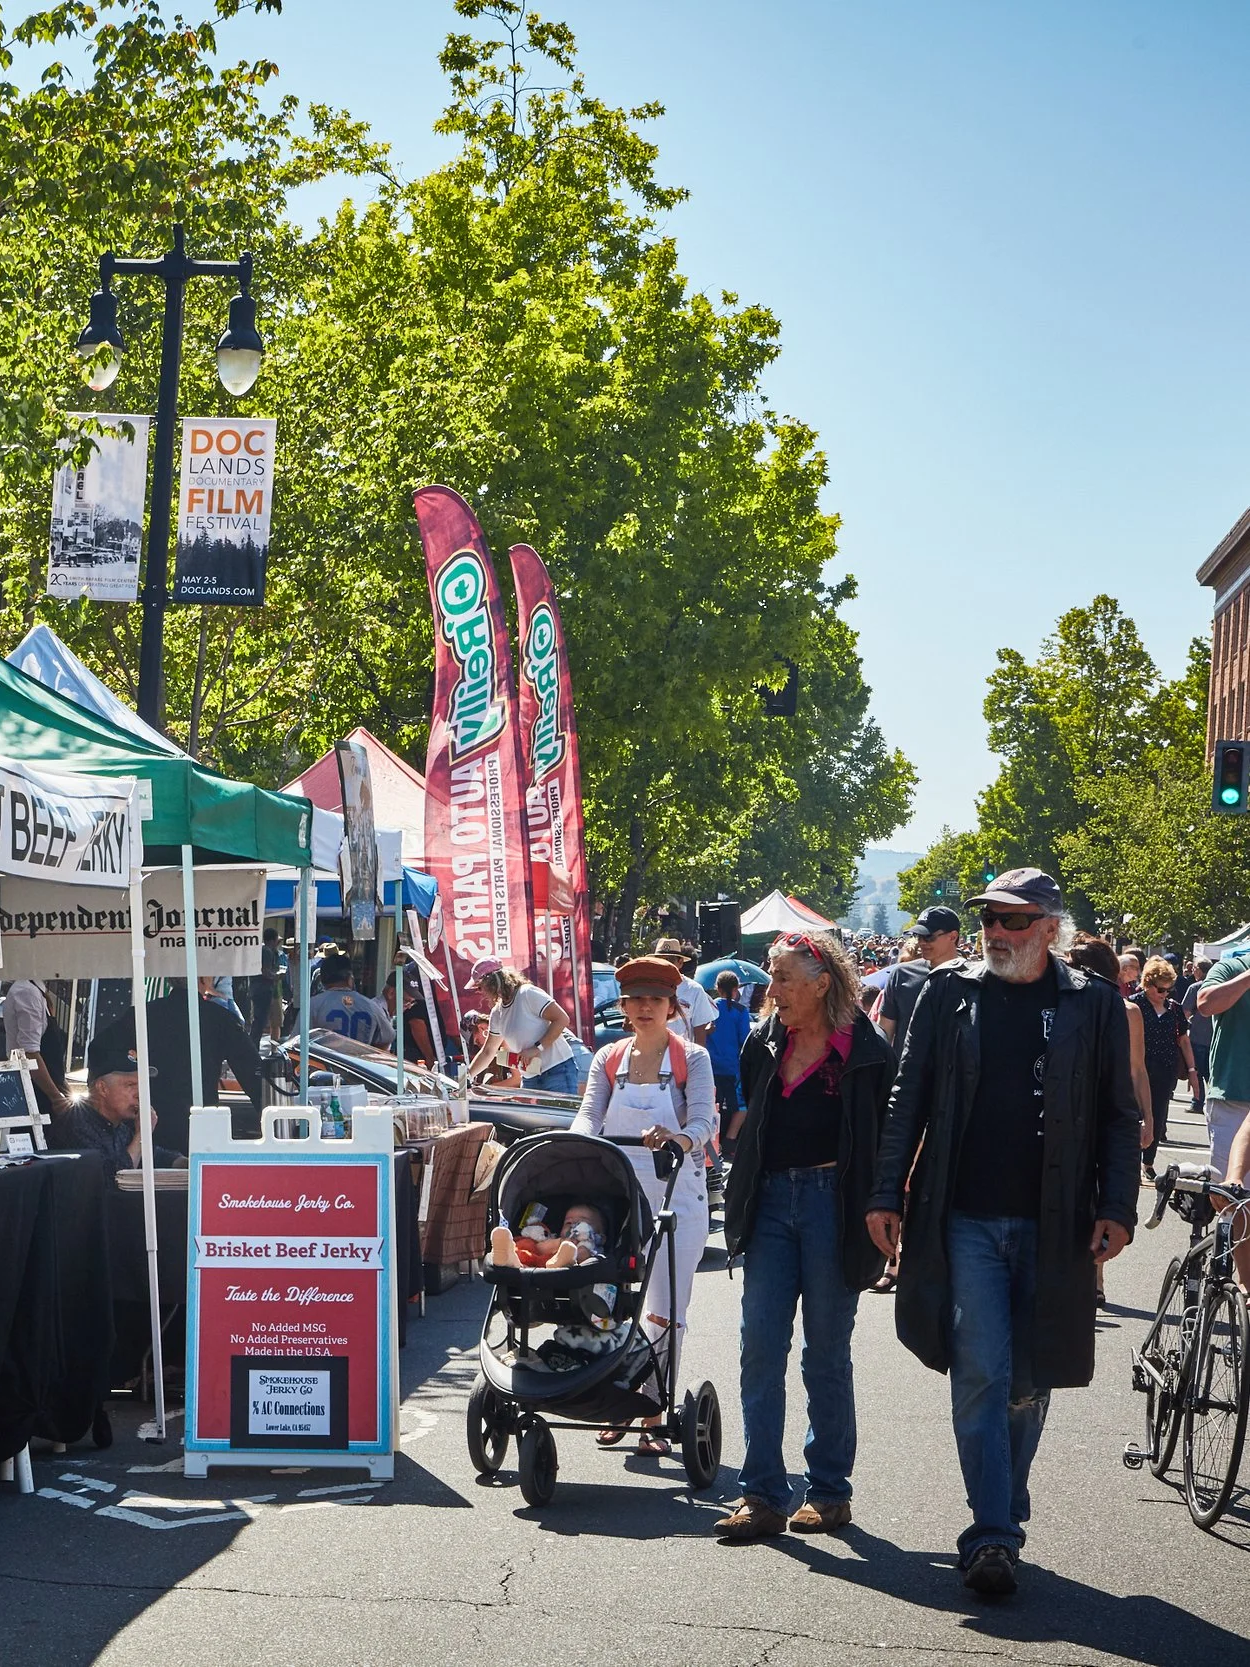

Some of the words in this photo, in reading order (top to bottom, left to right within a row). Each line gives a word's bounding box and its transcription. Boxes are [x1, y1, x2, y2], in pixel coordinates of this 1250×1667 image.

[190, 429, 265, 456] DOC
[189, 457, 265, 476] LANDS
[188, 477, 264, 487] DOCUMENTARY
[187, 489, 264, 515] FILM
[186, 516, 262, 531] FESTIVAL
[50, 573, 68, 586] 20
[182, 575, 202, 584] MAY
[204, 575, 217, 584] 2-5
[180, 586, 255, 596] DOCLANDS.COM
[160, 933, 259, 949] manij.com
[218, 1194, 292, 1209] Smokehouse
[294, 1194, 330, 1213] Jerky
[334, 1194, 355, 1209] Co.
[206, 1242, 271, 1258] Brisket
[276, 1242, 318, 1258] Beef
[320, 1243, 373, 1262] Jerky
[225, 1285, 258, 1301] Taste
[261, 1287, 281, 1301] the
[285, 1286, 354, 1305] Difference
[252, 1323, 266, 1332] No
[268, 1323, 300, 1332] Added
[303, 1323, 326, 1332] MSG
[230, 1334, 245, 1344] No
[247, 1334, 279, 1344] Added
[281, 1335, 348, 1345] Preservatives
[245, 1347, 272, 1356] Made
[274, 1347, 284, 1356] in
[286, 1347, 303, 1356] the
[305, 1347, 333, 1357] U.S.A.
[261, 1402, 273, 1416] AC
[274, 1401, 325, 1416] Connections
[266, 1423, 279, 1431] Lower
